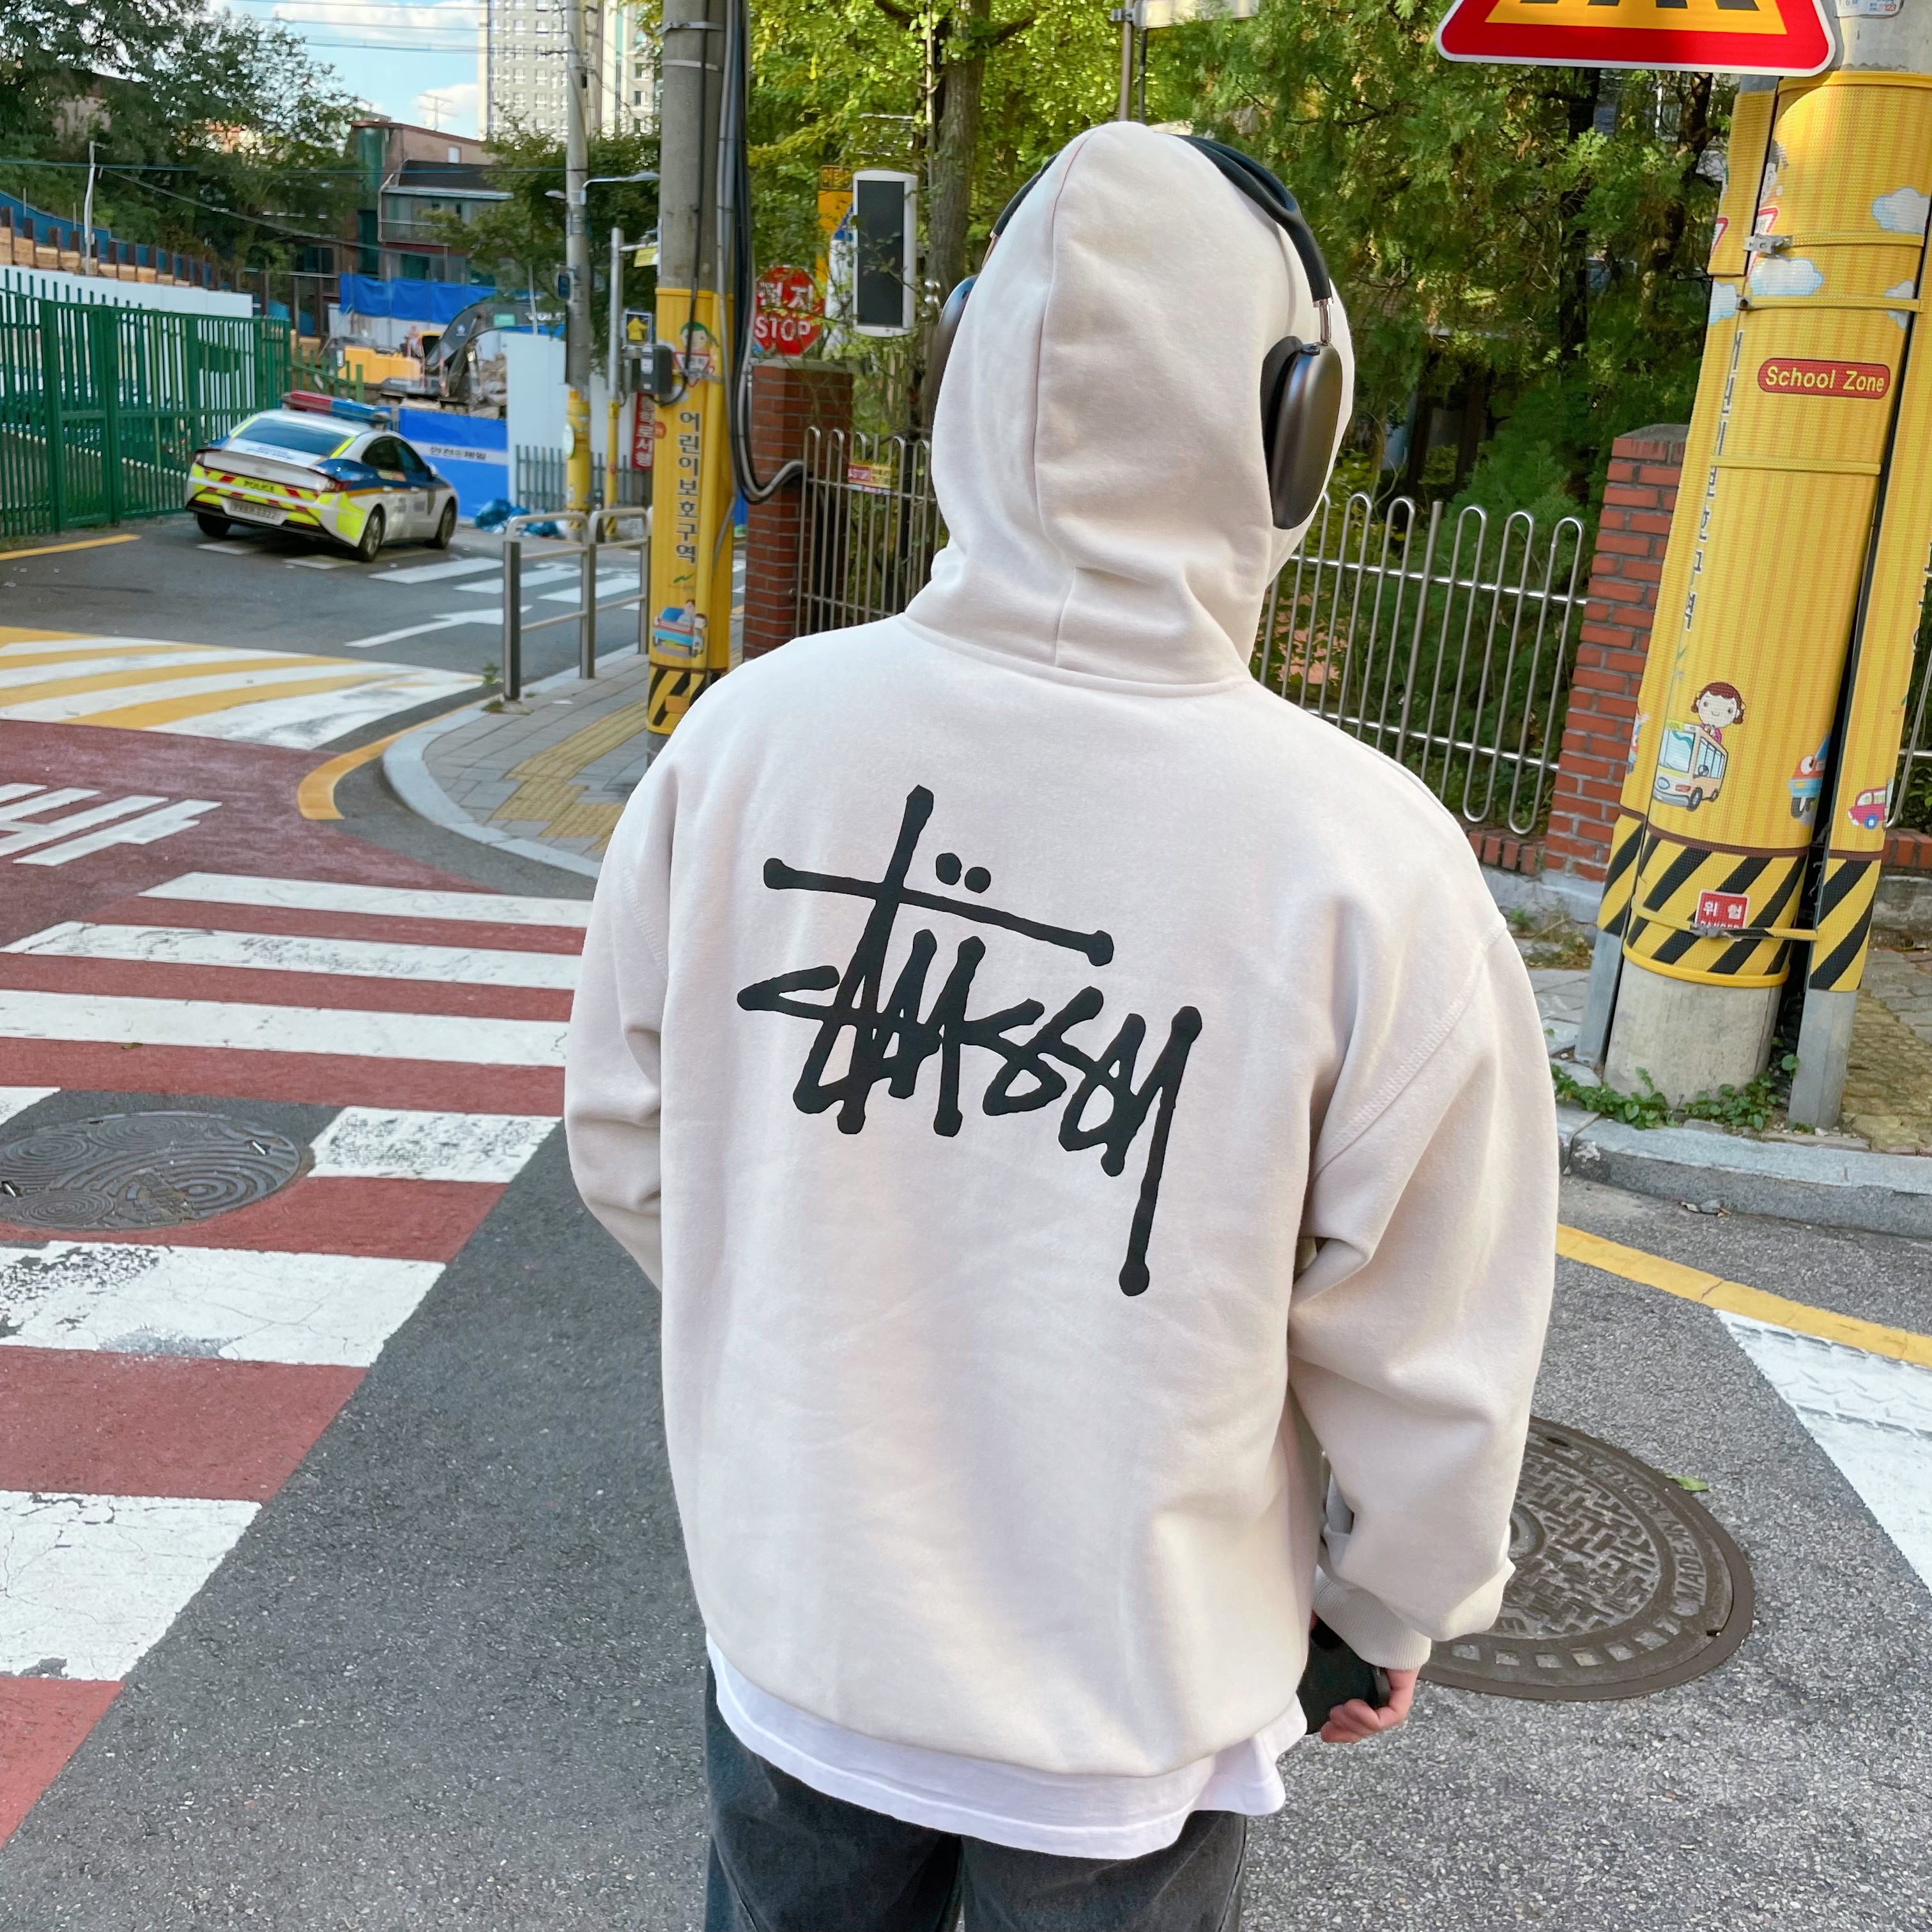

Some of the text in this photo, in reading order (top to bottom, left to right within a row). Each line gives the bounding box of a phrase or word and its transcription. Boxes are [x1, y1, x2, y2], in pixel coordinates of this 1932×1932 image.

[754, 316, 811, 342] STOP
[1765, 365, 1885, 392] School Zone
[675, 411, 700, 565] 어린이보호구역
